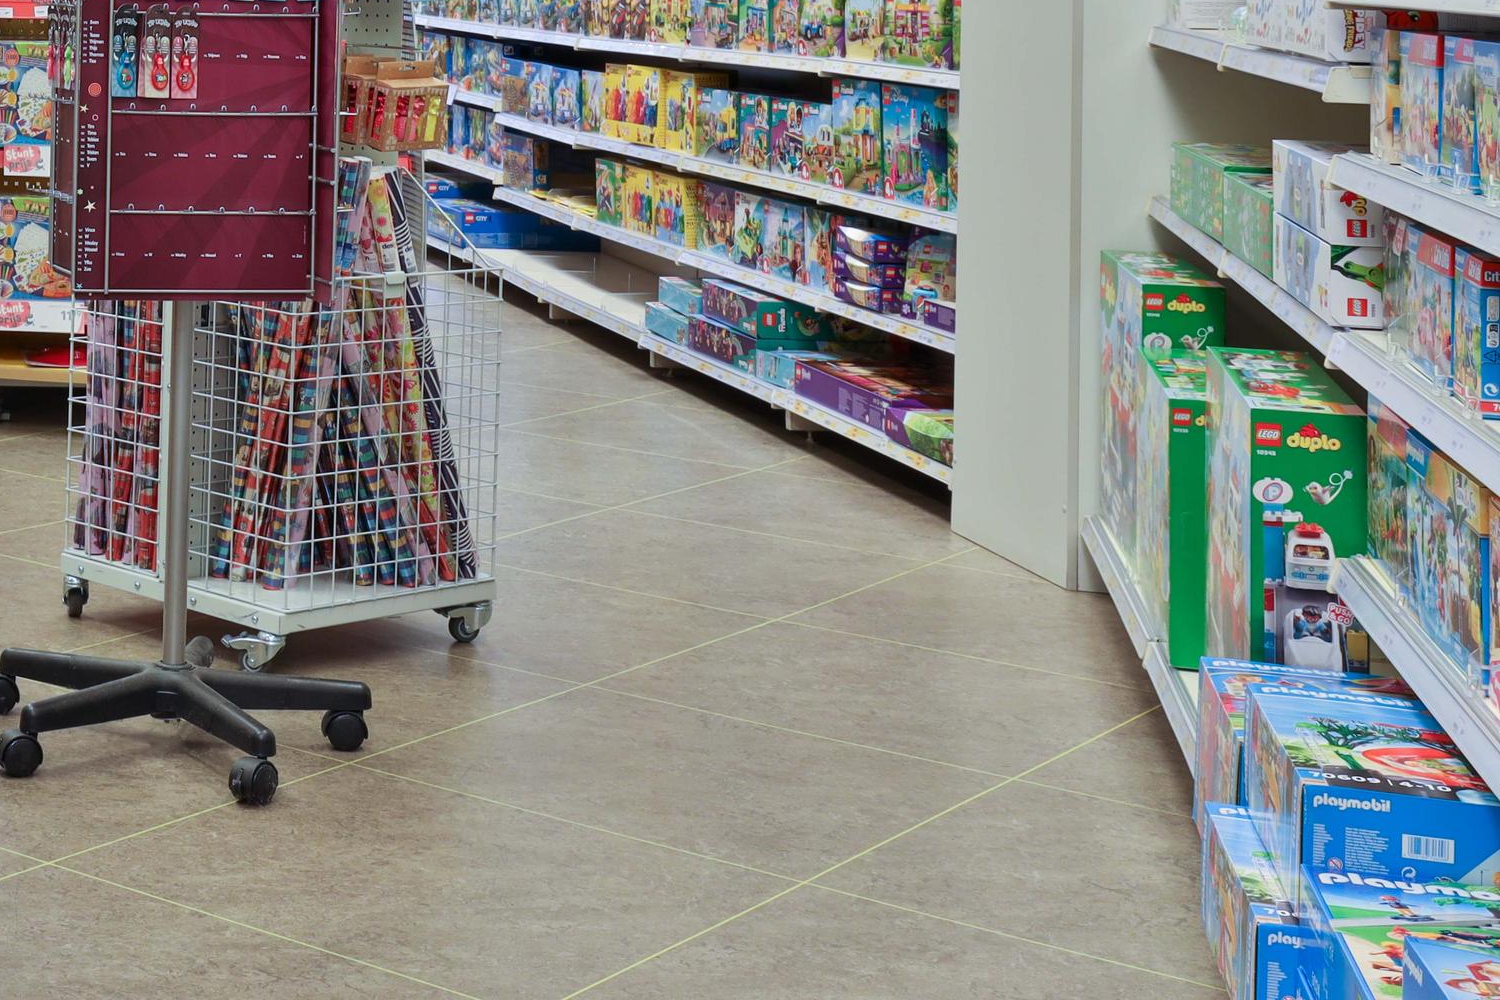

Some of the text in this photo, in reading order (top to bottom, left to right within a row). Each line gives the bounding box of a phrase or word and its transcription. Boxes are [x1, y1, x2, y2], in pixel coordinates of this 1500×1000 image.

[1354, 10, 1365, 49] PIDEY
[1258, 430, 1341, 453] LEGO duplo
[1213, 660, 1346, 678] playmobil
[1261, 686, 1413, 708] playmobil
[1308, 770, 1452, 793] 70609 4-10
[1313, 793, 1391, 812] playmobil
[1318, 872, 1500, 900] playmo
